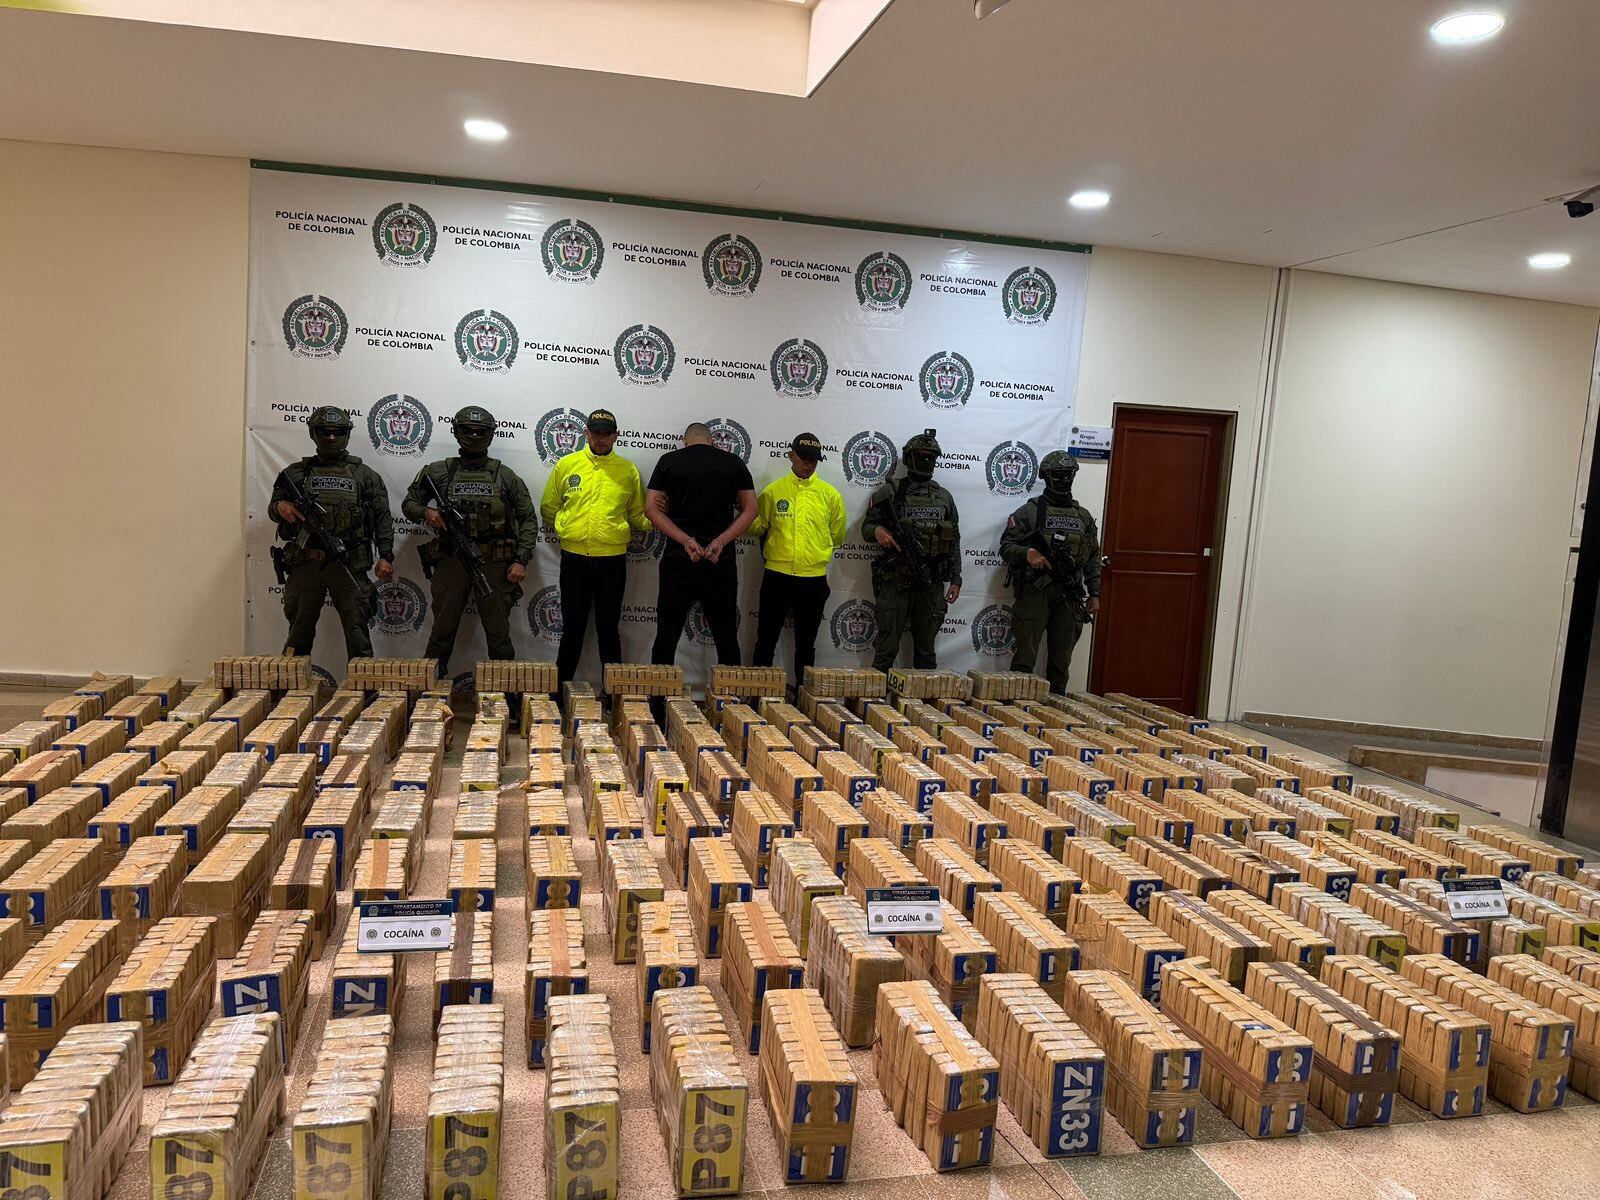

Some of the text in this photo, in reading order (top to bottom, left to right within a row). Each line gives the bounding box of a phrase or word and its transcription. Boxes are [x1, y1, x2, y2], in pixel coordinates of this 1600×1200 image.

[276, 211, 367, 225] POLICÍA NACIONAL
[304, 224, 354, 235] COLOMBIA
[443, 226, 533, 240] POLICÍA NACIONAL
[470, 239, 520, 250] COLOMBIA
[613, 243, 698, 258] POLICÍA NACIONAL
[639, 256, 686, 267] COLOMBIA
[771, 259, 852, 273] POLICÍA NACIONAL
[795, 272, 840, 282] COLOMBIA
[920, 274, 998, 287] POLICÍA NACIONAL
[943, 286, 986, 296] COLOMBIA
[356, 328, 446, 341] POLICÍA NACIONAL
[383, 340, 433, 350] COLOMBIA
[524, 342, 612, 356] POLICÍA NACIONAL
[551, 355, 599, 365] COLOMBIA
[685, 358, 767, 370] POLICÍA NACIONAL
[709, 370, 755, 379] COLOMBIA
[836, 369, 914, 381] POLICÍA NACIONAL
[859, 381, 902, 390] COLOMBIA
[980, 381, 1054, 392] POLICÍA NACIONAL
[1002, 392, 1043, 400] COLOMBIA
[272, 404, 310, 412] POLICÍA
[643, 432, 684, 440] NACIONA
[631, 441, 677, 450] COLOMBIA
[760, 440, 793, 449] POLICÍA
[393, 528, 428, 536] LOMBIA
[1465, 900, 1490, 908] COCAÍNA
[888, 913, 920, 922] COCAÍNA
[384, 928, 424, 938] COCAÍNA
[1058, 1066, 1094, 1151] ZN33
[691, 1093, 735, 1193] P87
[304, 1132, 352, 1194] 87
[165, 1140, 214, 1200] 87
